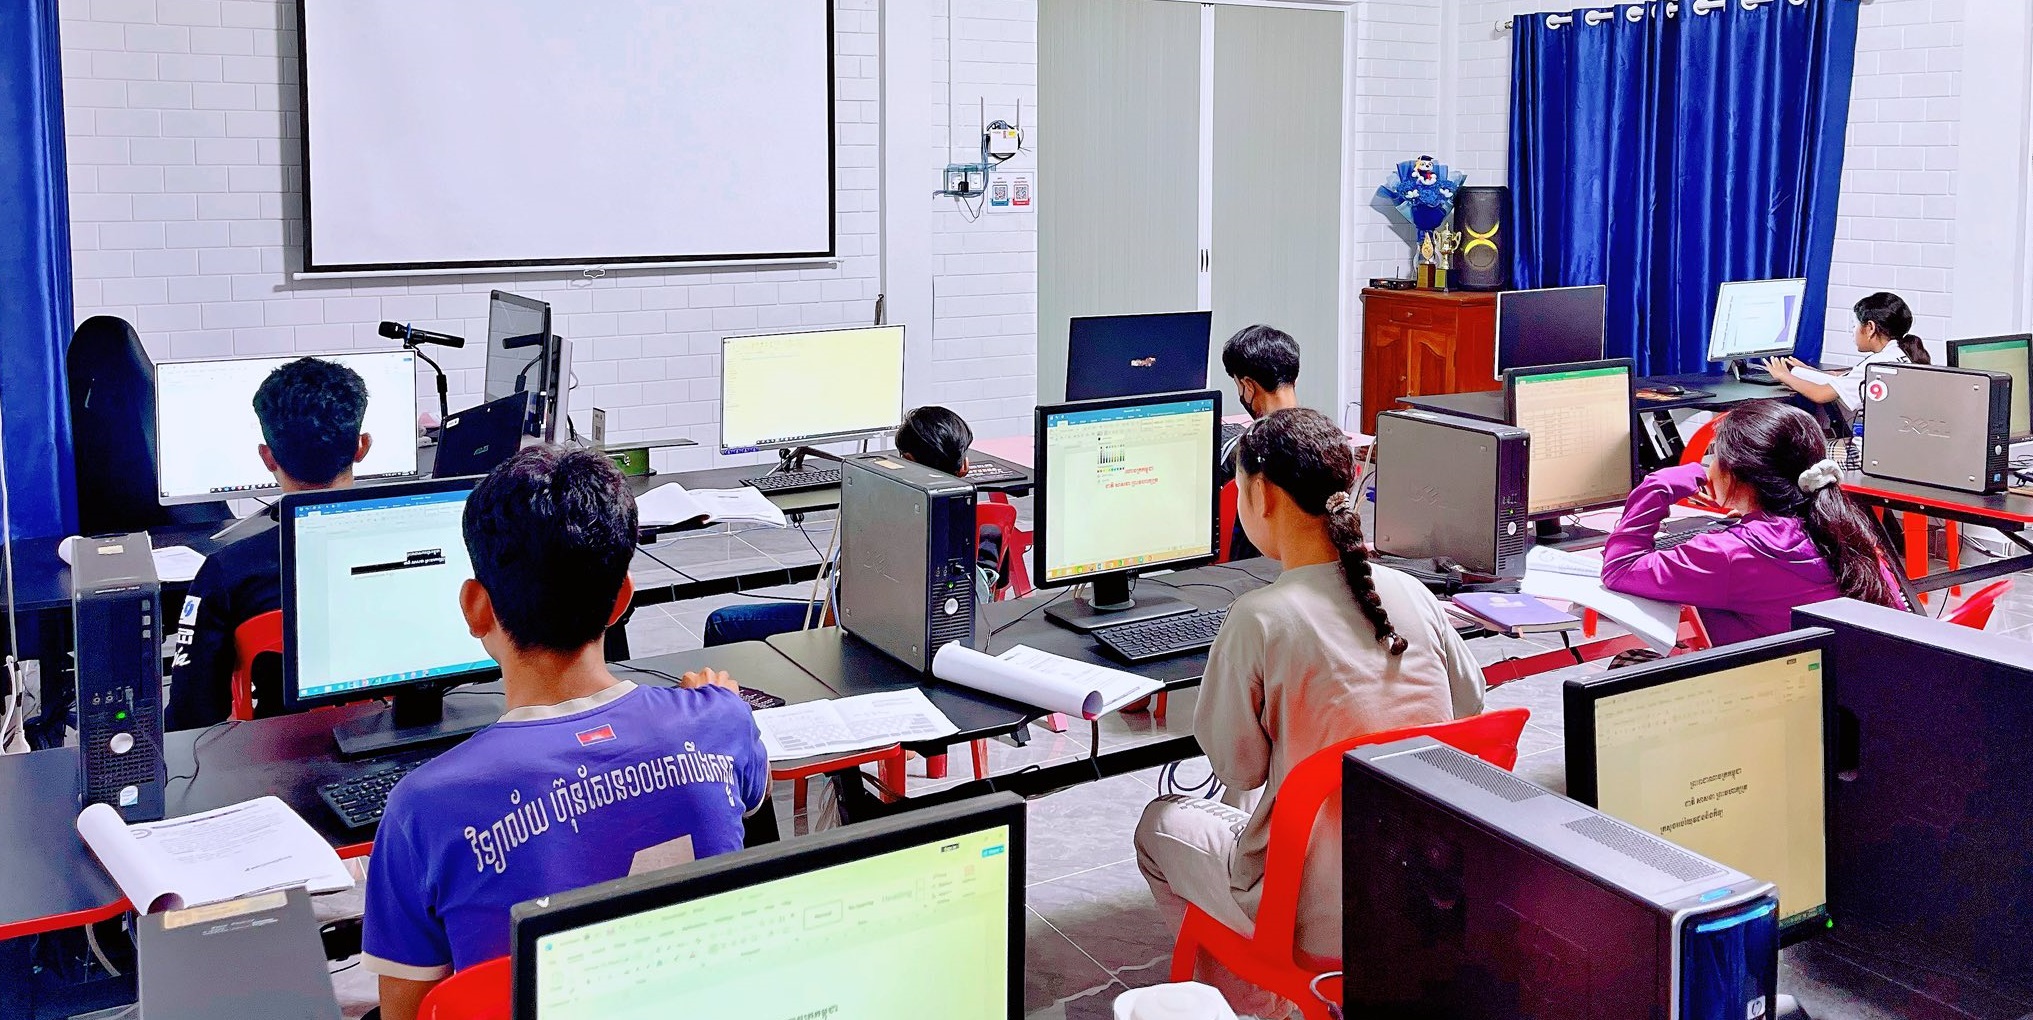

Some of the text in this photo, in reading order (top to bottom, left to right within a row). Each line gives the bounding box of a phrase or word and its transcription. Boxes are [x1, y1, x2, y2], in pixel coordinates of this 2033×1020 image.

[1869, 383, 1883, 400] 9
[464, 788, 550, 874] វិទ្យាល័យ
